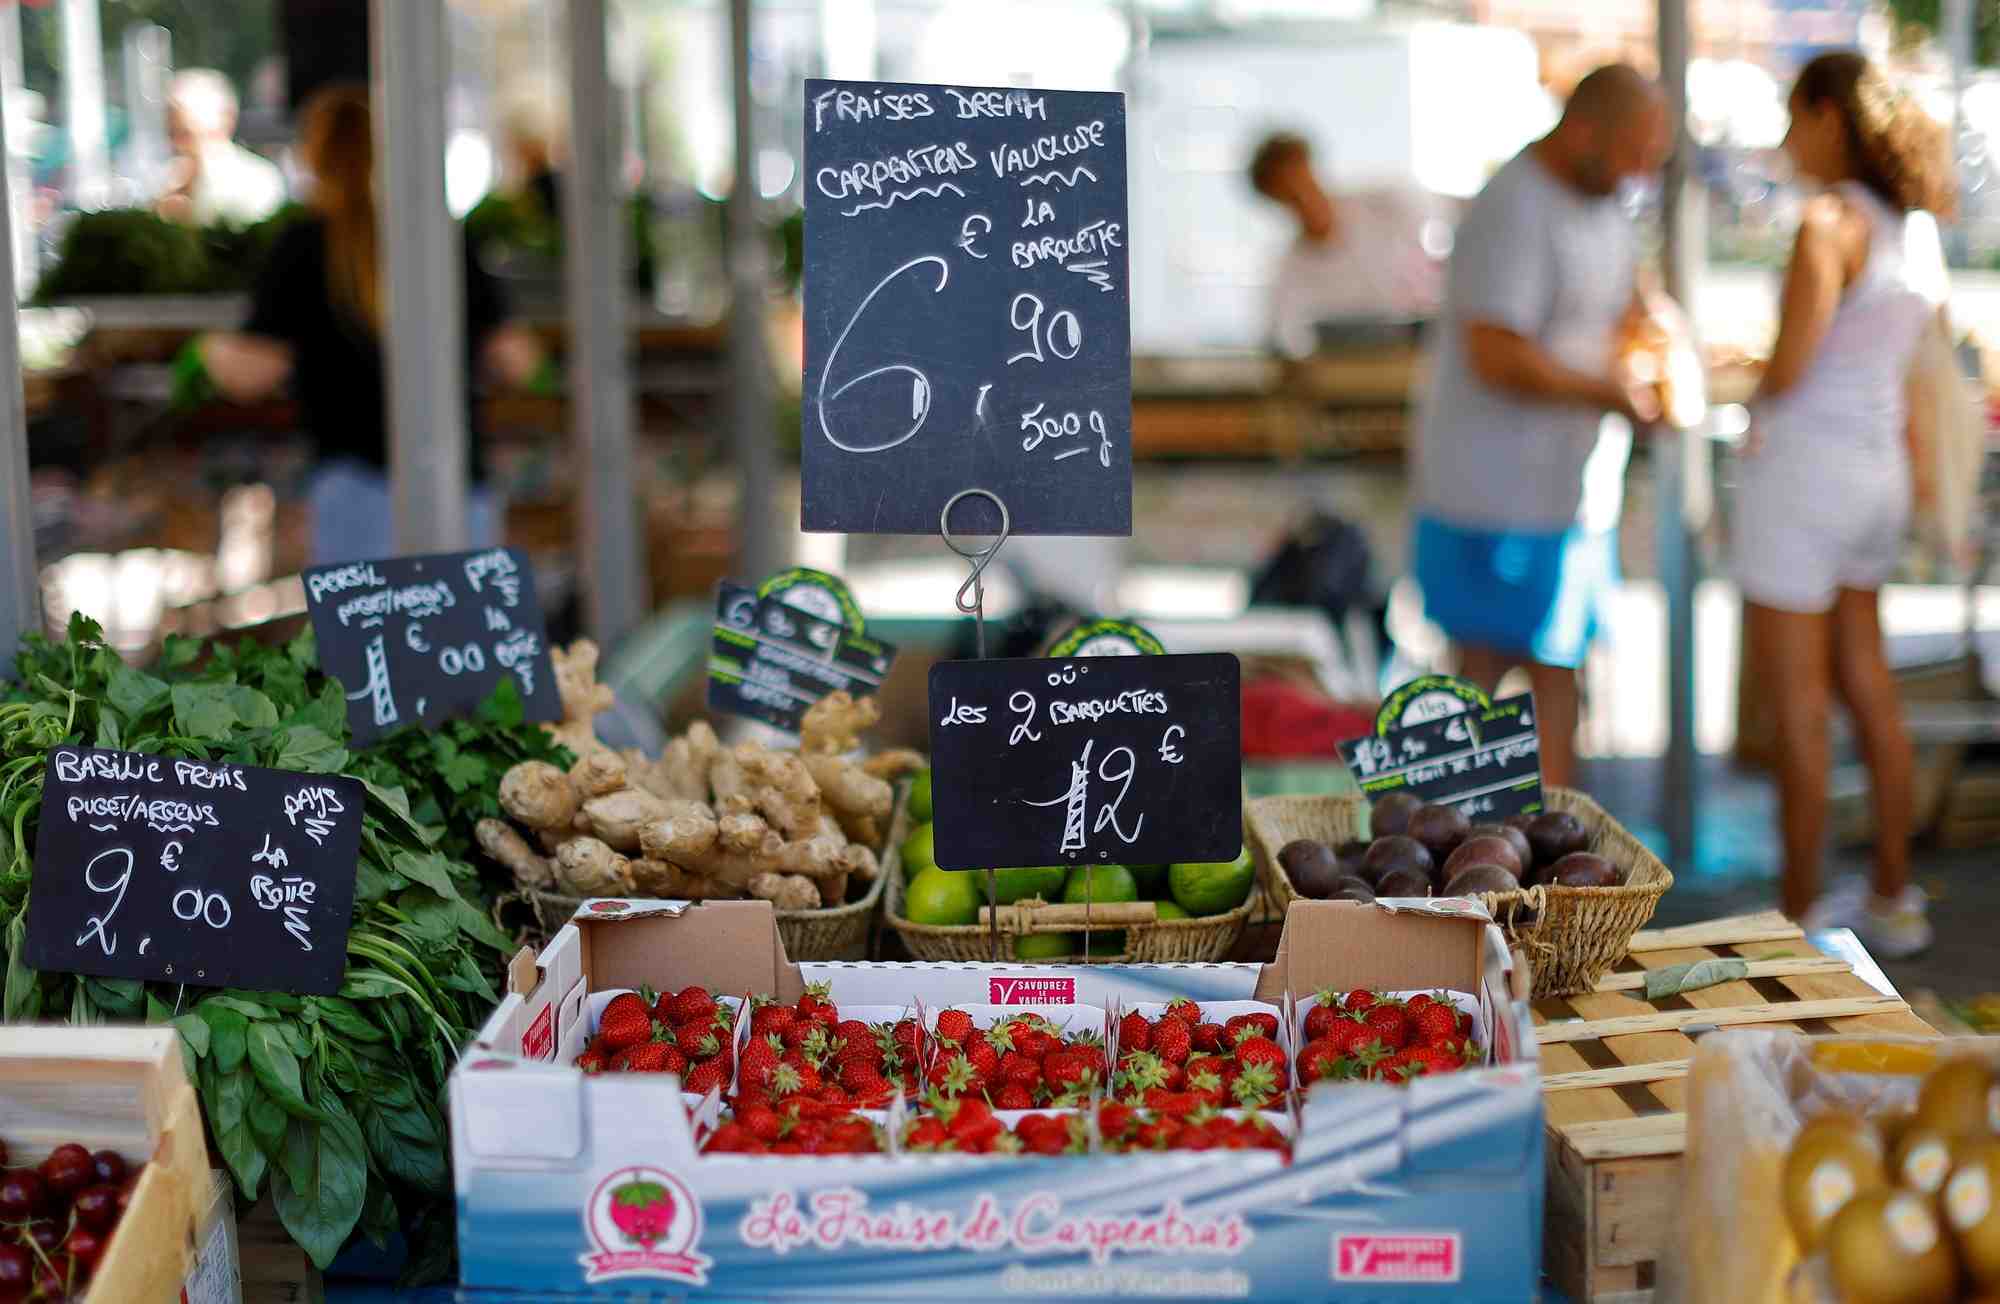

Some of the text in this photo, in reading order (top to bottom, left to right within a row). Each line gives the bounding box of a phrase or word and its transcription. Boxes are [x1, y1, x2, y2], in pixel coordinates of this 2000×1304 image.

[813, 89, 935, 132] FRAISES
[816, 121, 1105, 199] CARPENTRAS VAUCLUSE
[1022, 199, 1056, 228] LA
[1012, 220, 1121, 269] BARQUETTE
[1007, 293, 1082, 363] 90
[1009, 691, 1041, 745] 2
[1050, 689, 1167, 726] BARQUETTES
[174, 761, 248, 791] FRAIS
[1021, 725, 1185, 854] 12 €
[251, 833, 288, 869] LA
[172, 889, 232, 929] 00
[1018, 981, 1067, 990] SAVOUREZ
[1018, 996, 1068, 1005] VAUCLUSE
[816, 1194, 942, 1245] Fraise
[963, 1196, 999, 1242] de
